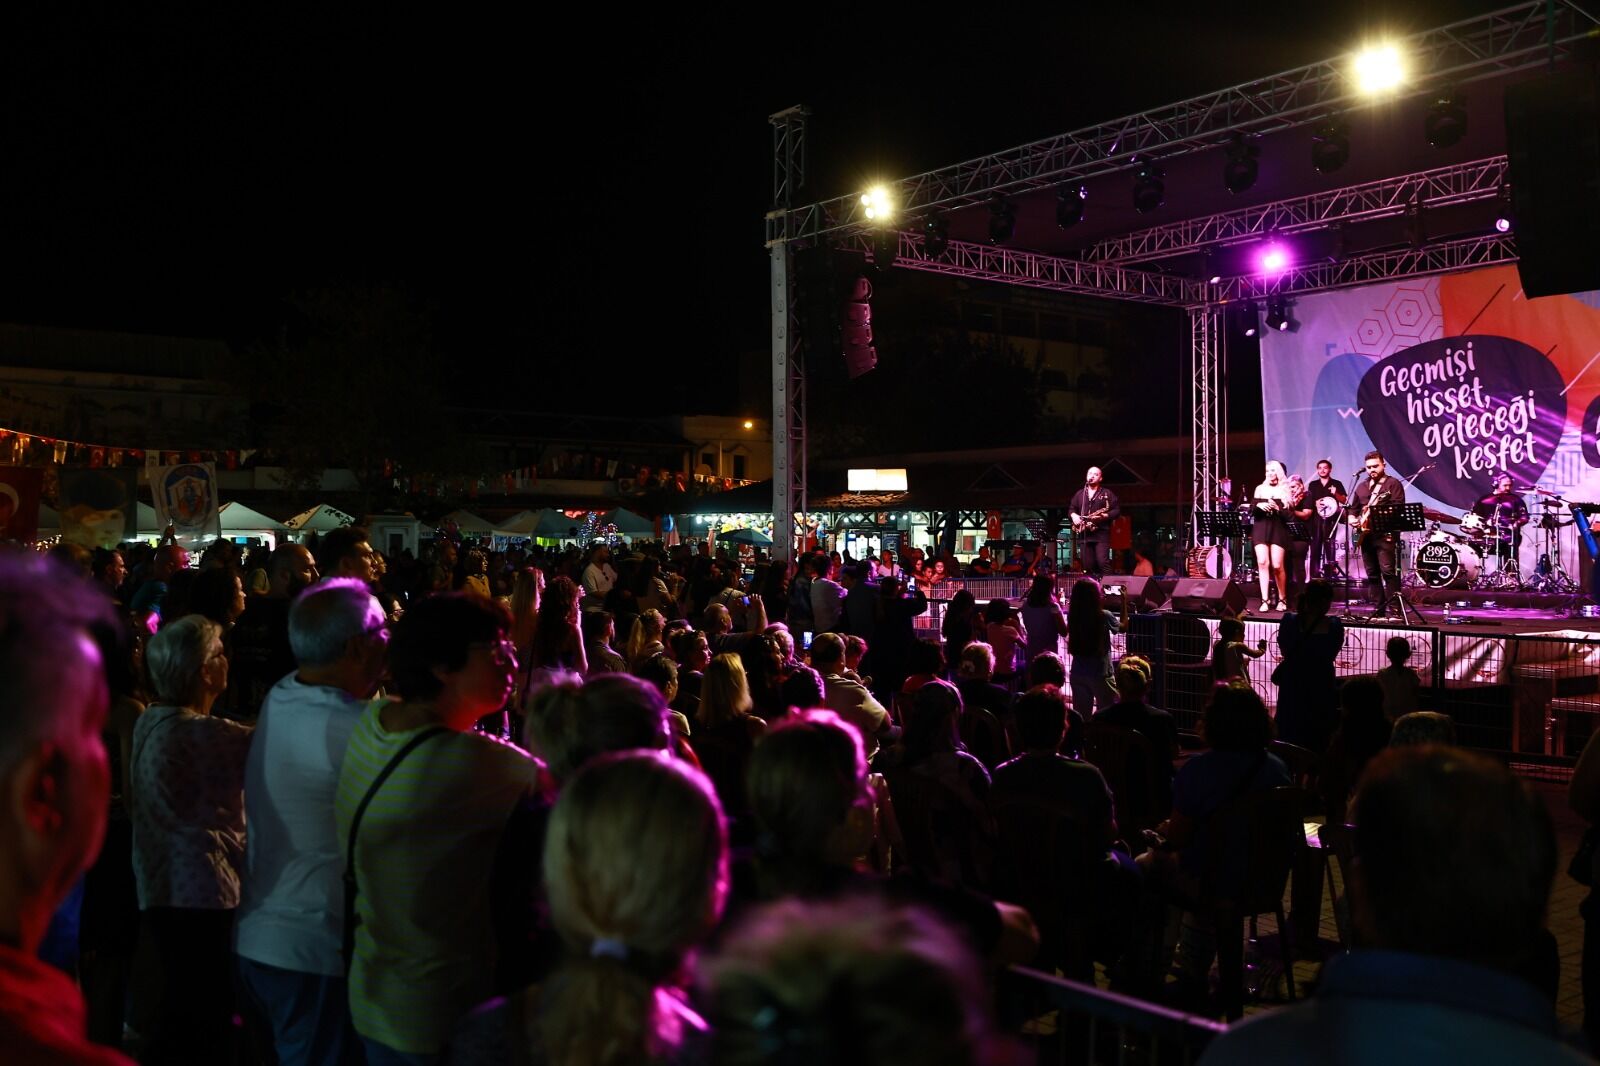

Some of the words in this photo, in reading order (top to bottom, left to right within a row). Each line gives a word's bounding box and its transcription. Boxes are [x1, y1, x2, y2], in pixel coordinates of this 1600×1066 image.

[1380, 341, 1476, 397] Geçmişi
[1407, 377, 1490, 424] hisset,
[1423, 390, 1537, 458] geleceği
[1454, 432, 1538, 479] keşfet
